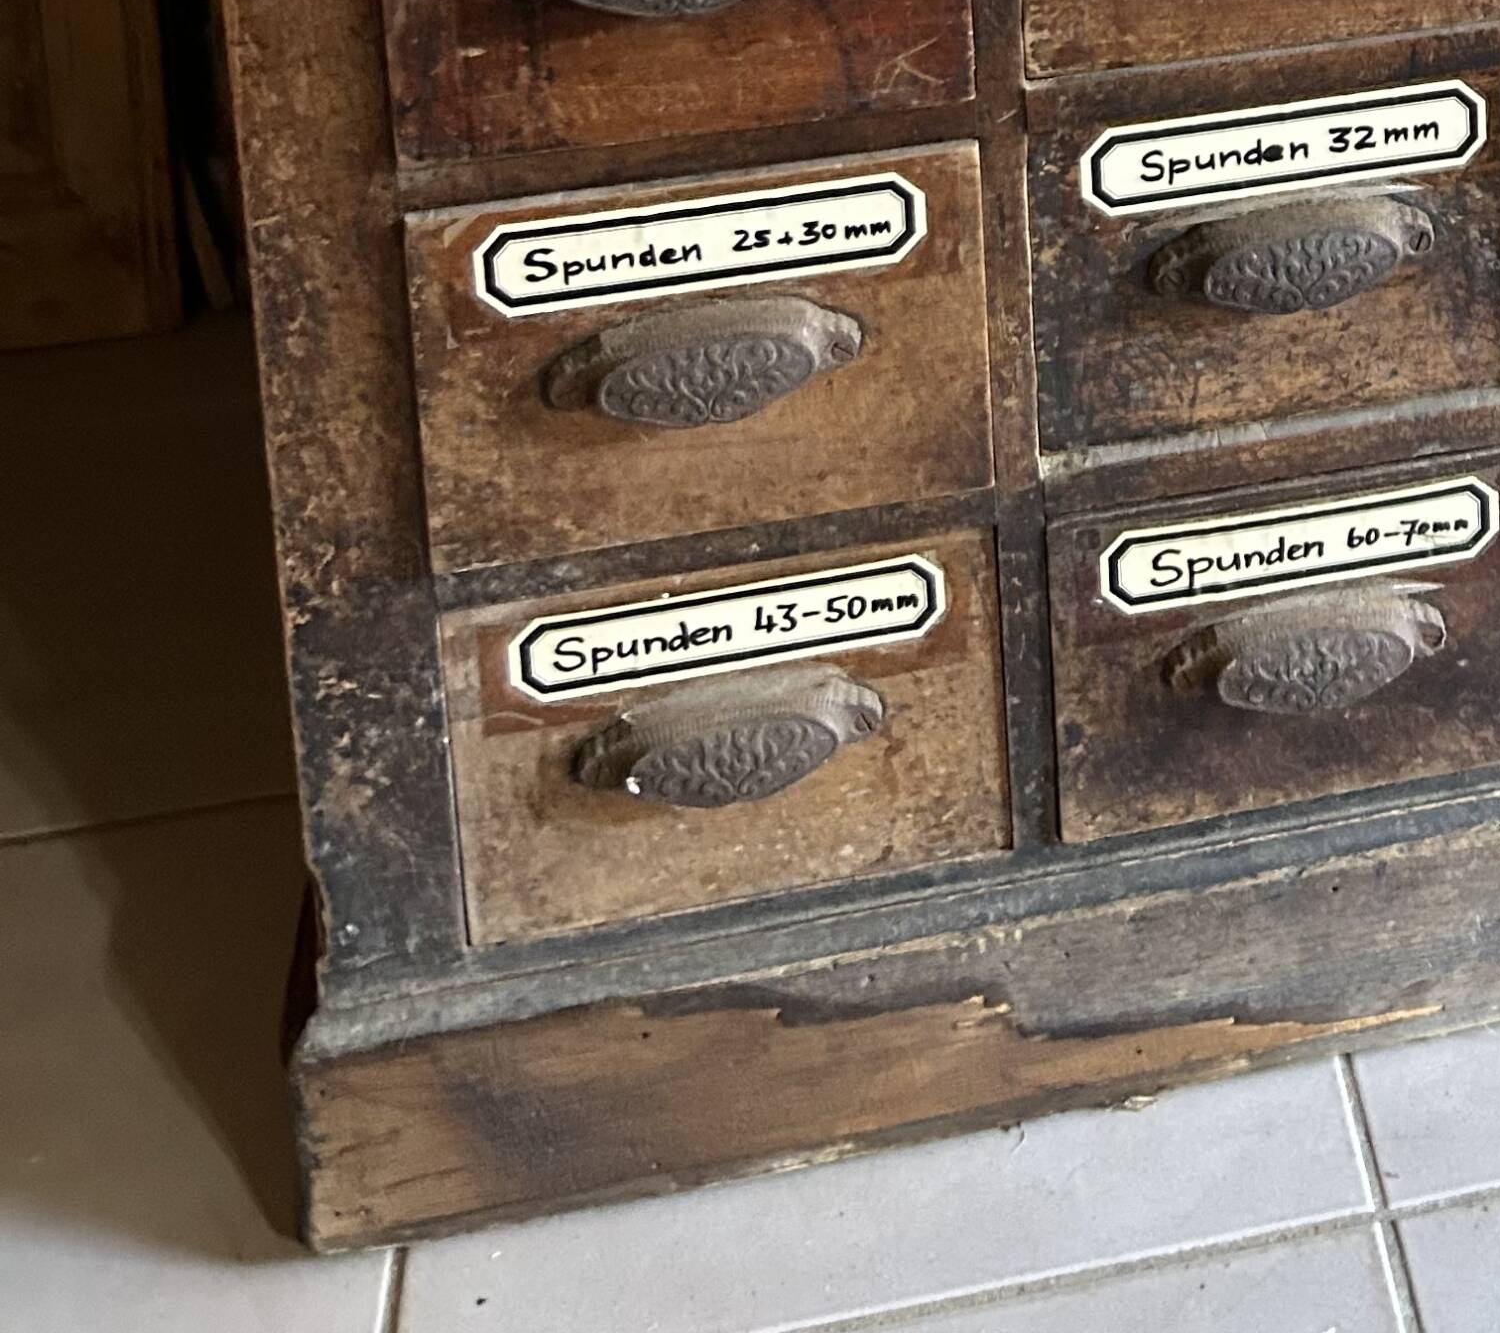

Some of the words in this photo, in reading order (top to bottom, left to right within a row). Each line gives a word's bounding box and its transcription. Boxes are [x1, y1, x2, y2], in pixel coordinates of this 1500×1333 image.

[1139, 138, 1309, 185] Spunden
[522, 242, 703, 286] Spunden
[1149, 536, 1324, 594] Spunden
[552, 621, 733, 675] Spunden
